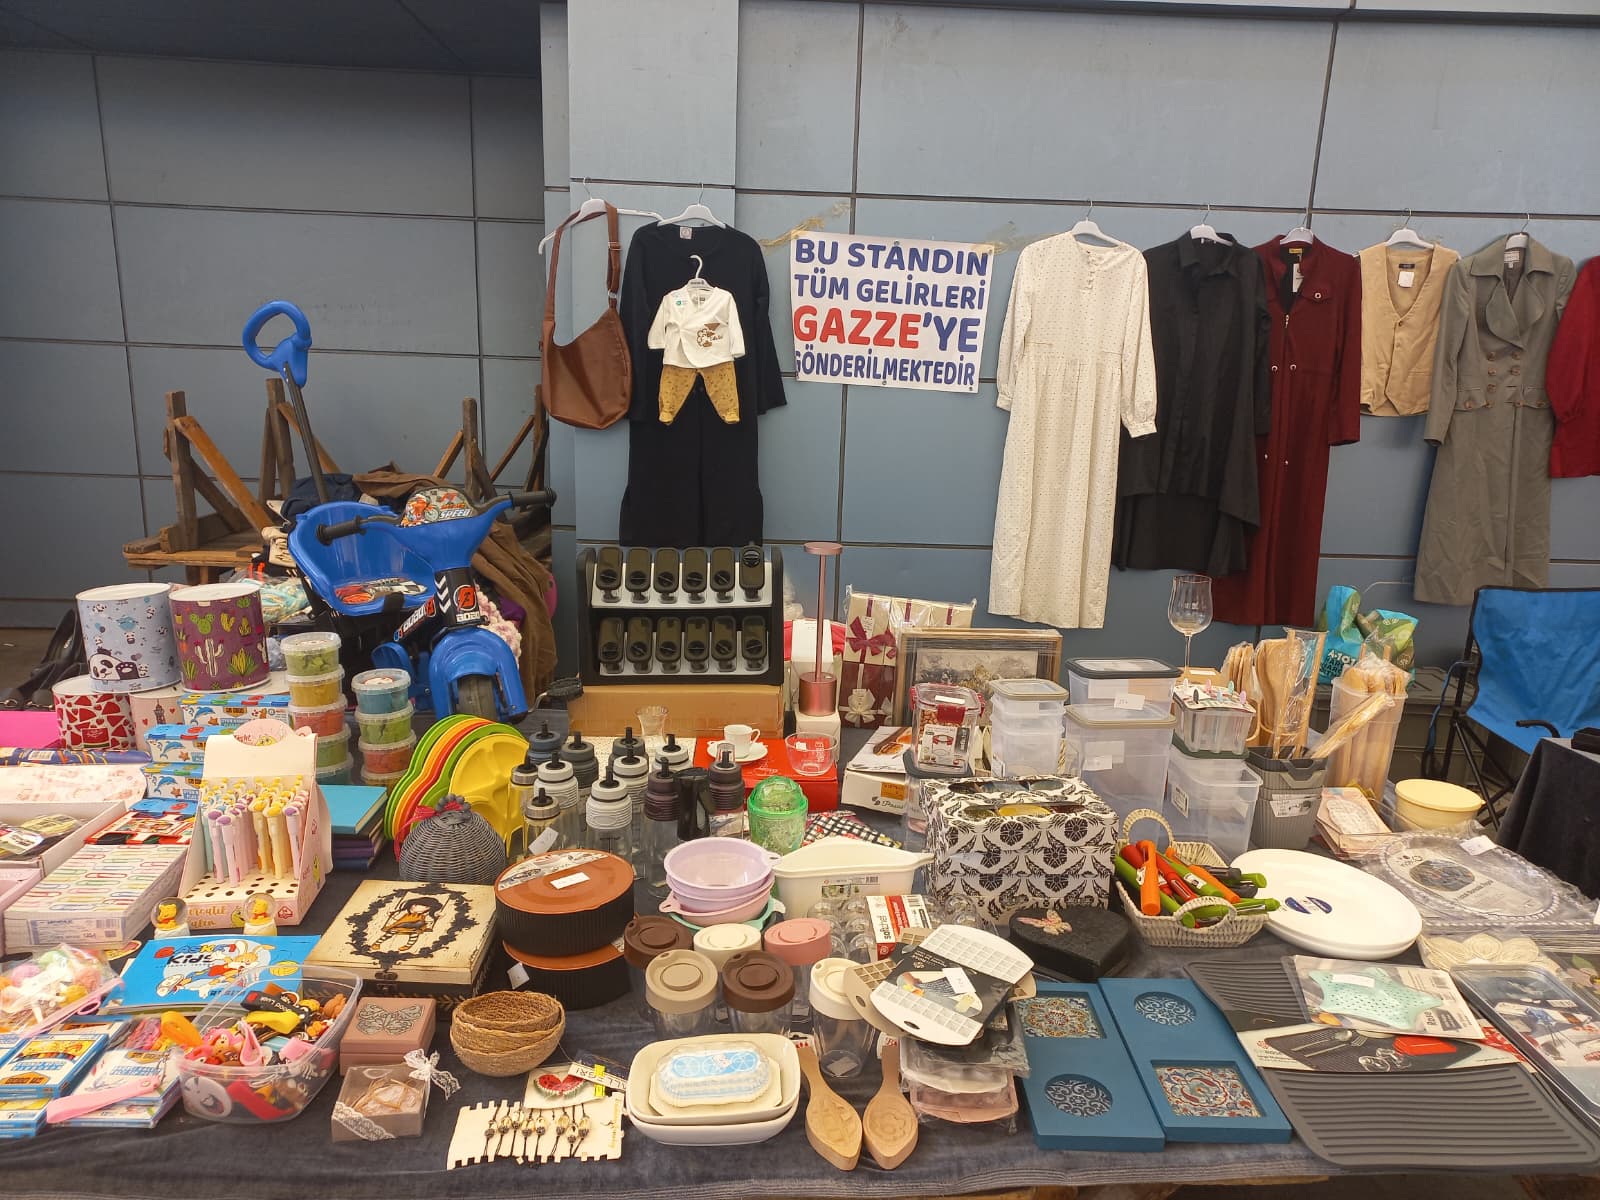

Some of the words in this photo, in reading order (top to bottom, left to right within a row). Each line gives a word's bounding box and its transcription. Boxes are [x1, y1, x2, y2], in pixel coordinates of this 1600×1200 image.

[795, 239, 839, 265] BU
[847, 243, 989, 276] STANDIN
[794, 267, 849, 300] TÜM
[856, 274, 986, 310] GELİRLERİ
[793, 305, 981, 352] GAZZE'YE
